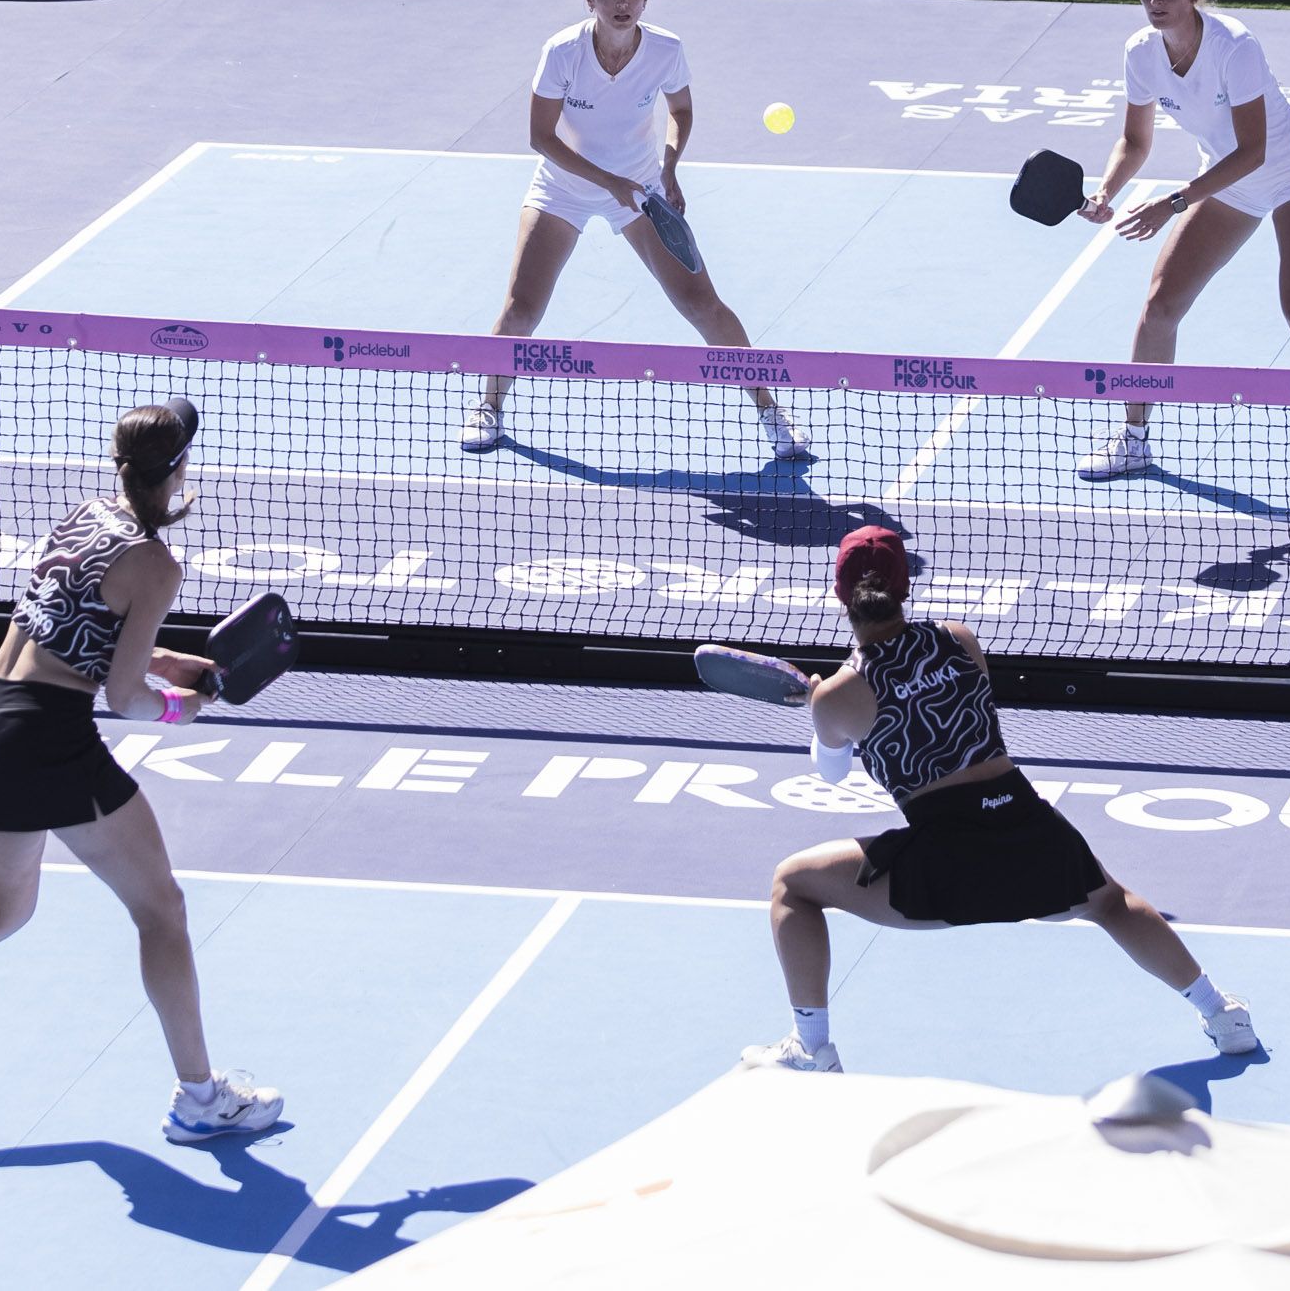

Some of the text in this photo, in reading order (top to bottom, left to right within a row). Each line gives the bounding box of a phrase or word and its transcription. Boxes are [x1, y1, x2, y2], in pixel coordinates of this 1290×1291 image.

[155, 333, 204, 347] ASTURIANA
[349, 343, 410, 359] picklebull
[513, 343, 573, 360] PICKLE
[706, 351, 785, 366] CERVEZAS
[699, 365, 792, 383] VICTORIA
[894, 359, 953, 376] PICKLE
[1111, 374, 1174, 391] picklebull
[894, 665, 960, 700] GLAUKA
